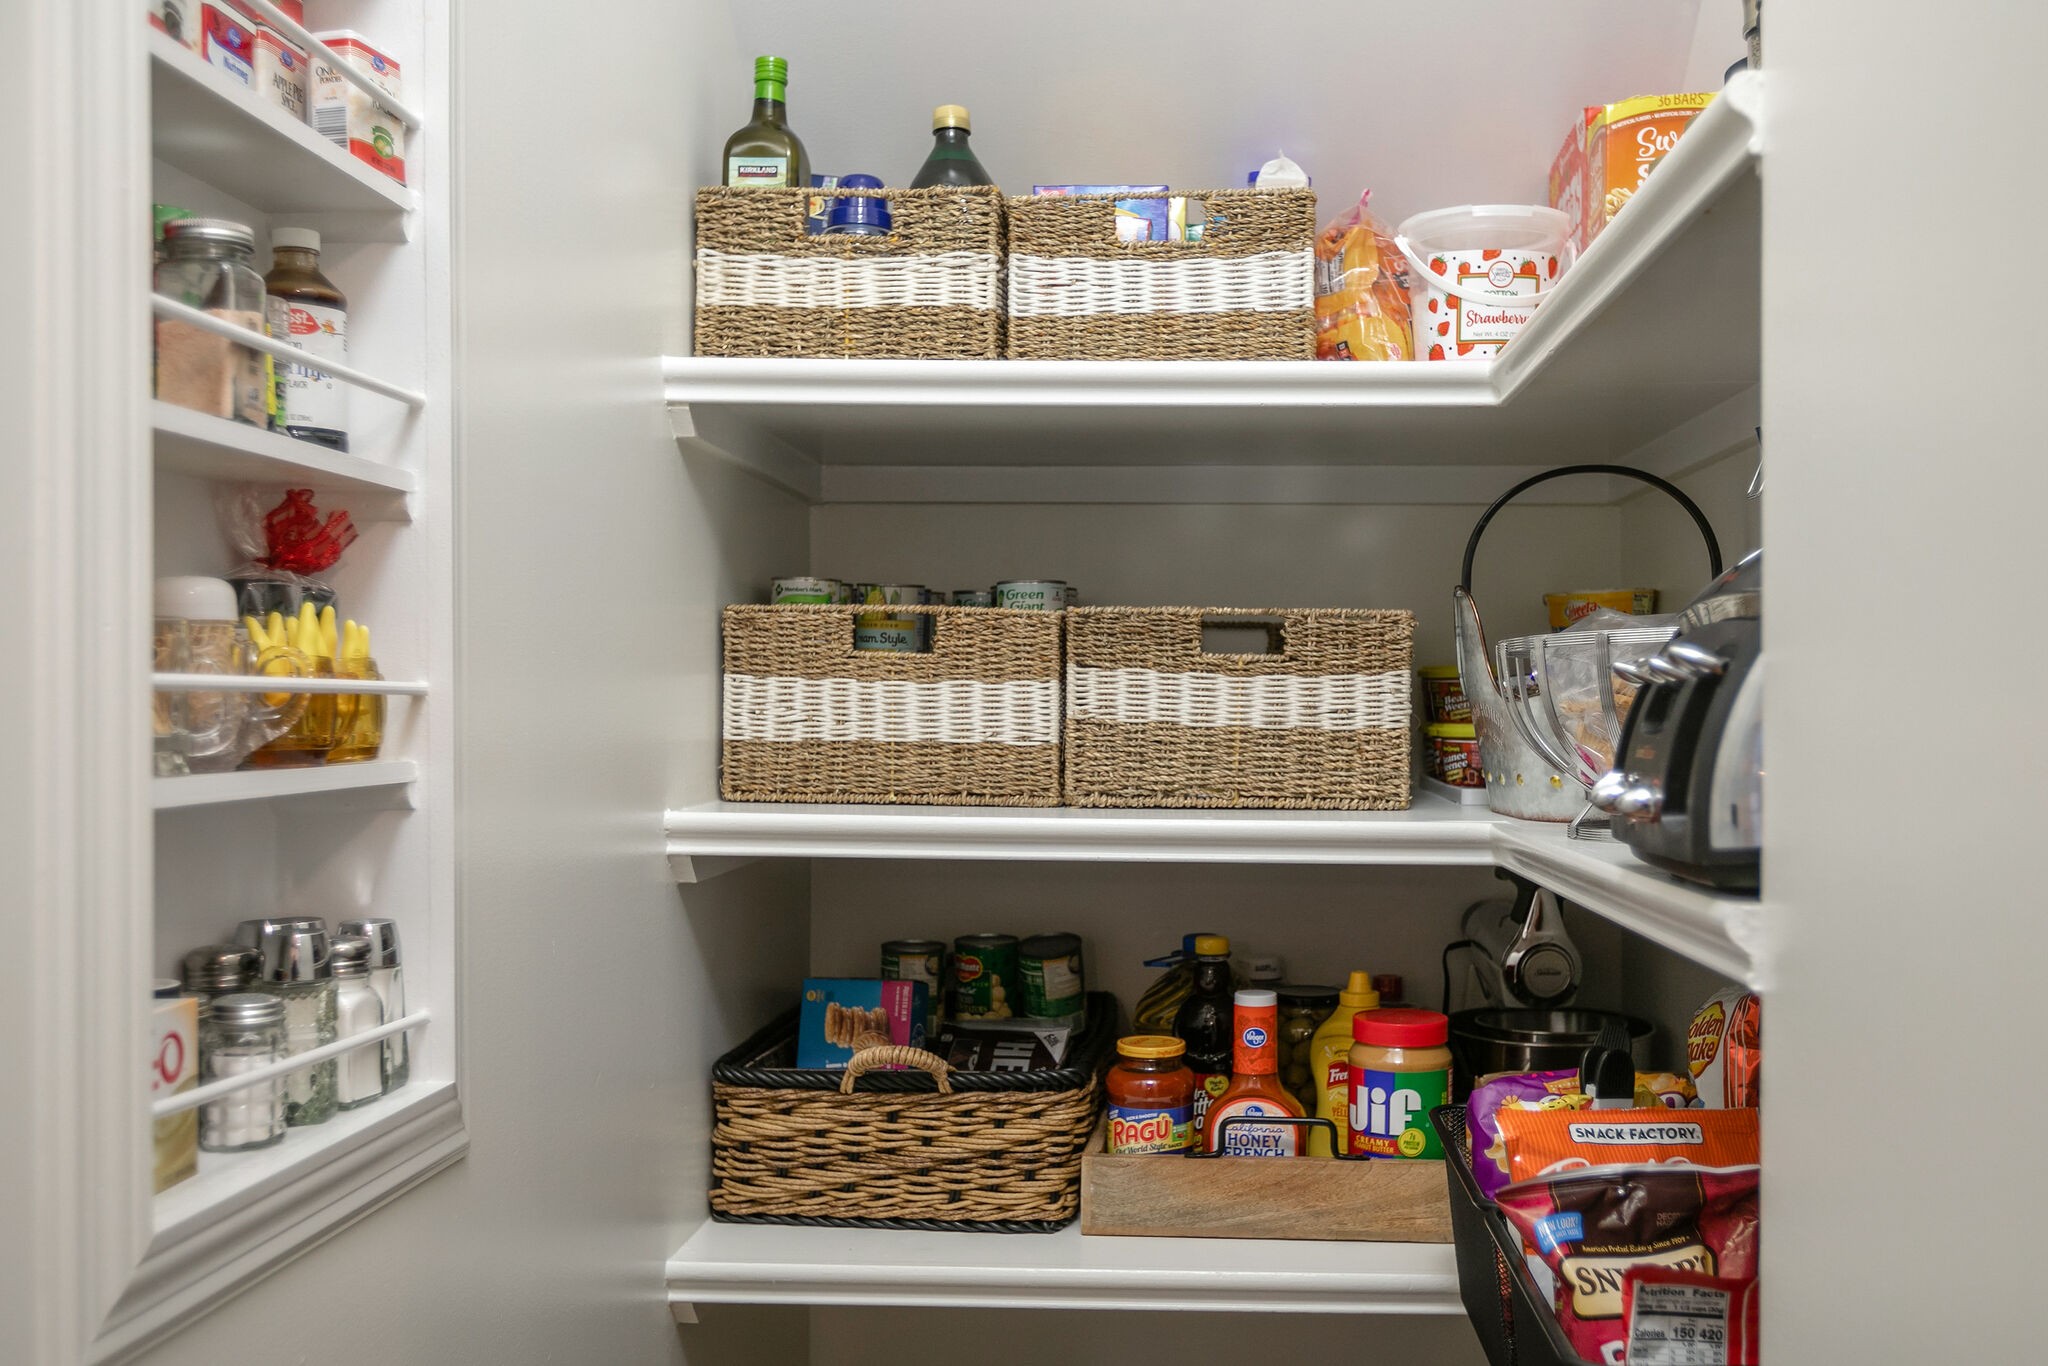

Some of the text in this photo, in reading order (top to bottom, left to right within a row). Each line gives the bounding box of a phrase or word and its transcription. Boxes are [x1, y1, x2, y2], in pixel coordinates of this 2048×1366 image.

[1657, 93, 1704, 107] 36 BARS
[739, 166, 777, 175] KIRKLAND
[1006, 590, 1044, 600] Green
[880, 632, 908, 647] Style
[1349, 1085, 1422, 1136] Jif
[1226, 1123, 1285, 1136] alifornia
[1575, 1127, 1696, 1140] SNACK FACTORY
[1227, 1134, 1282, 1148] HONEY
[1355, 1135, 1390, 1147] CREAMY
[1128, 1145, 1148, 1154] World
[1373, 1144, 1394, 1154] BUTTER
[1608, 1245, 1629, 1253] Pretzel
[1653, 1240, 1671, 1249] Since
[1692, 1288, 1725, 1298] Facts
[1634, 1326, 1724, 1341] Calories 150 420
